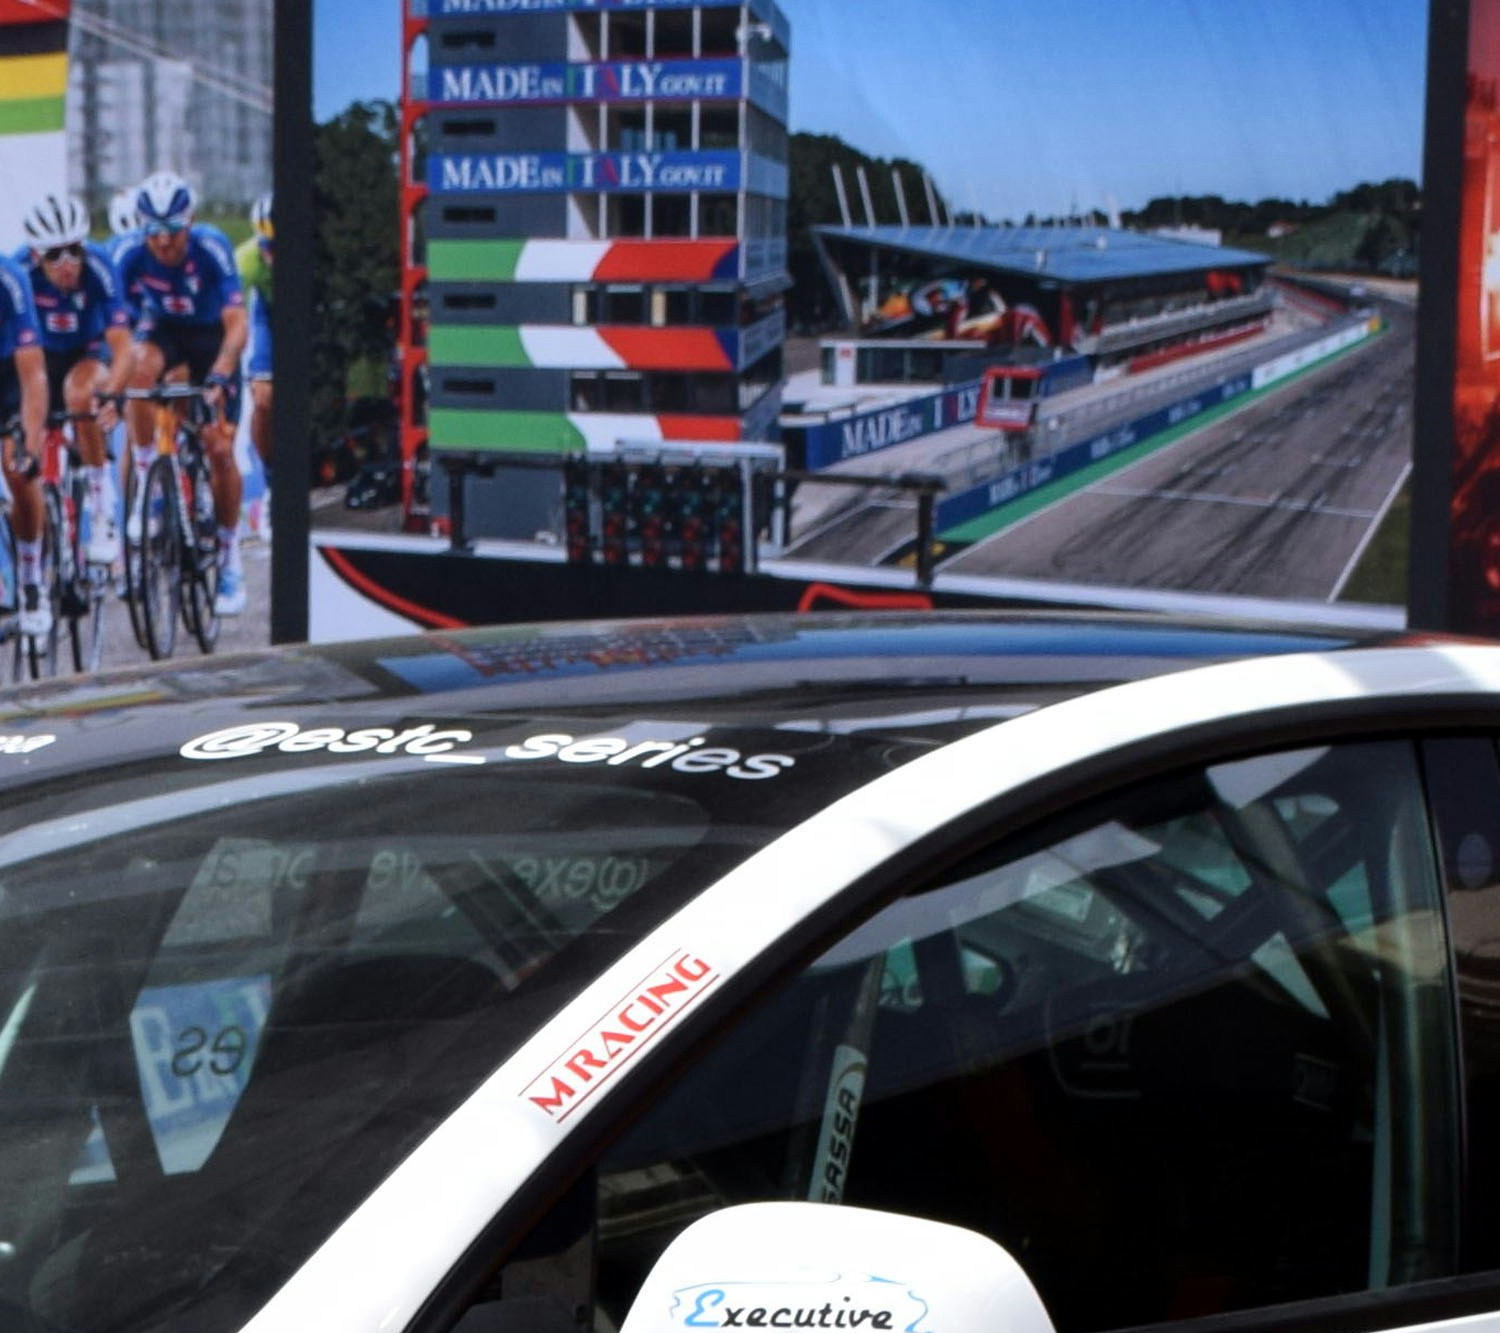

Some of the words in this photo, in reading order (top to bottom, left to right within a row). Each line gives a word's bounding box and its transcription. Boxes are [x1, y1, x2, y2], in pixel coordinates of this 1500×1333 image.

[180, 721, 796, 780] @estc_series
[564, 953, 712, 1085] RACING
[683, 1288, 894, 1332] Executive
